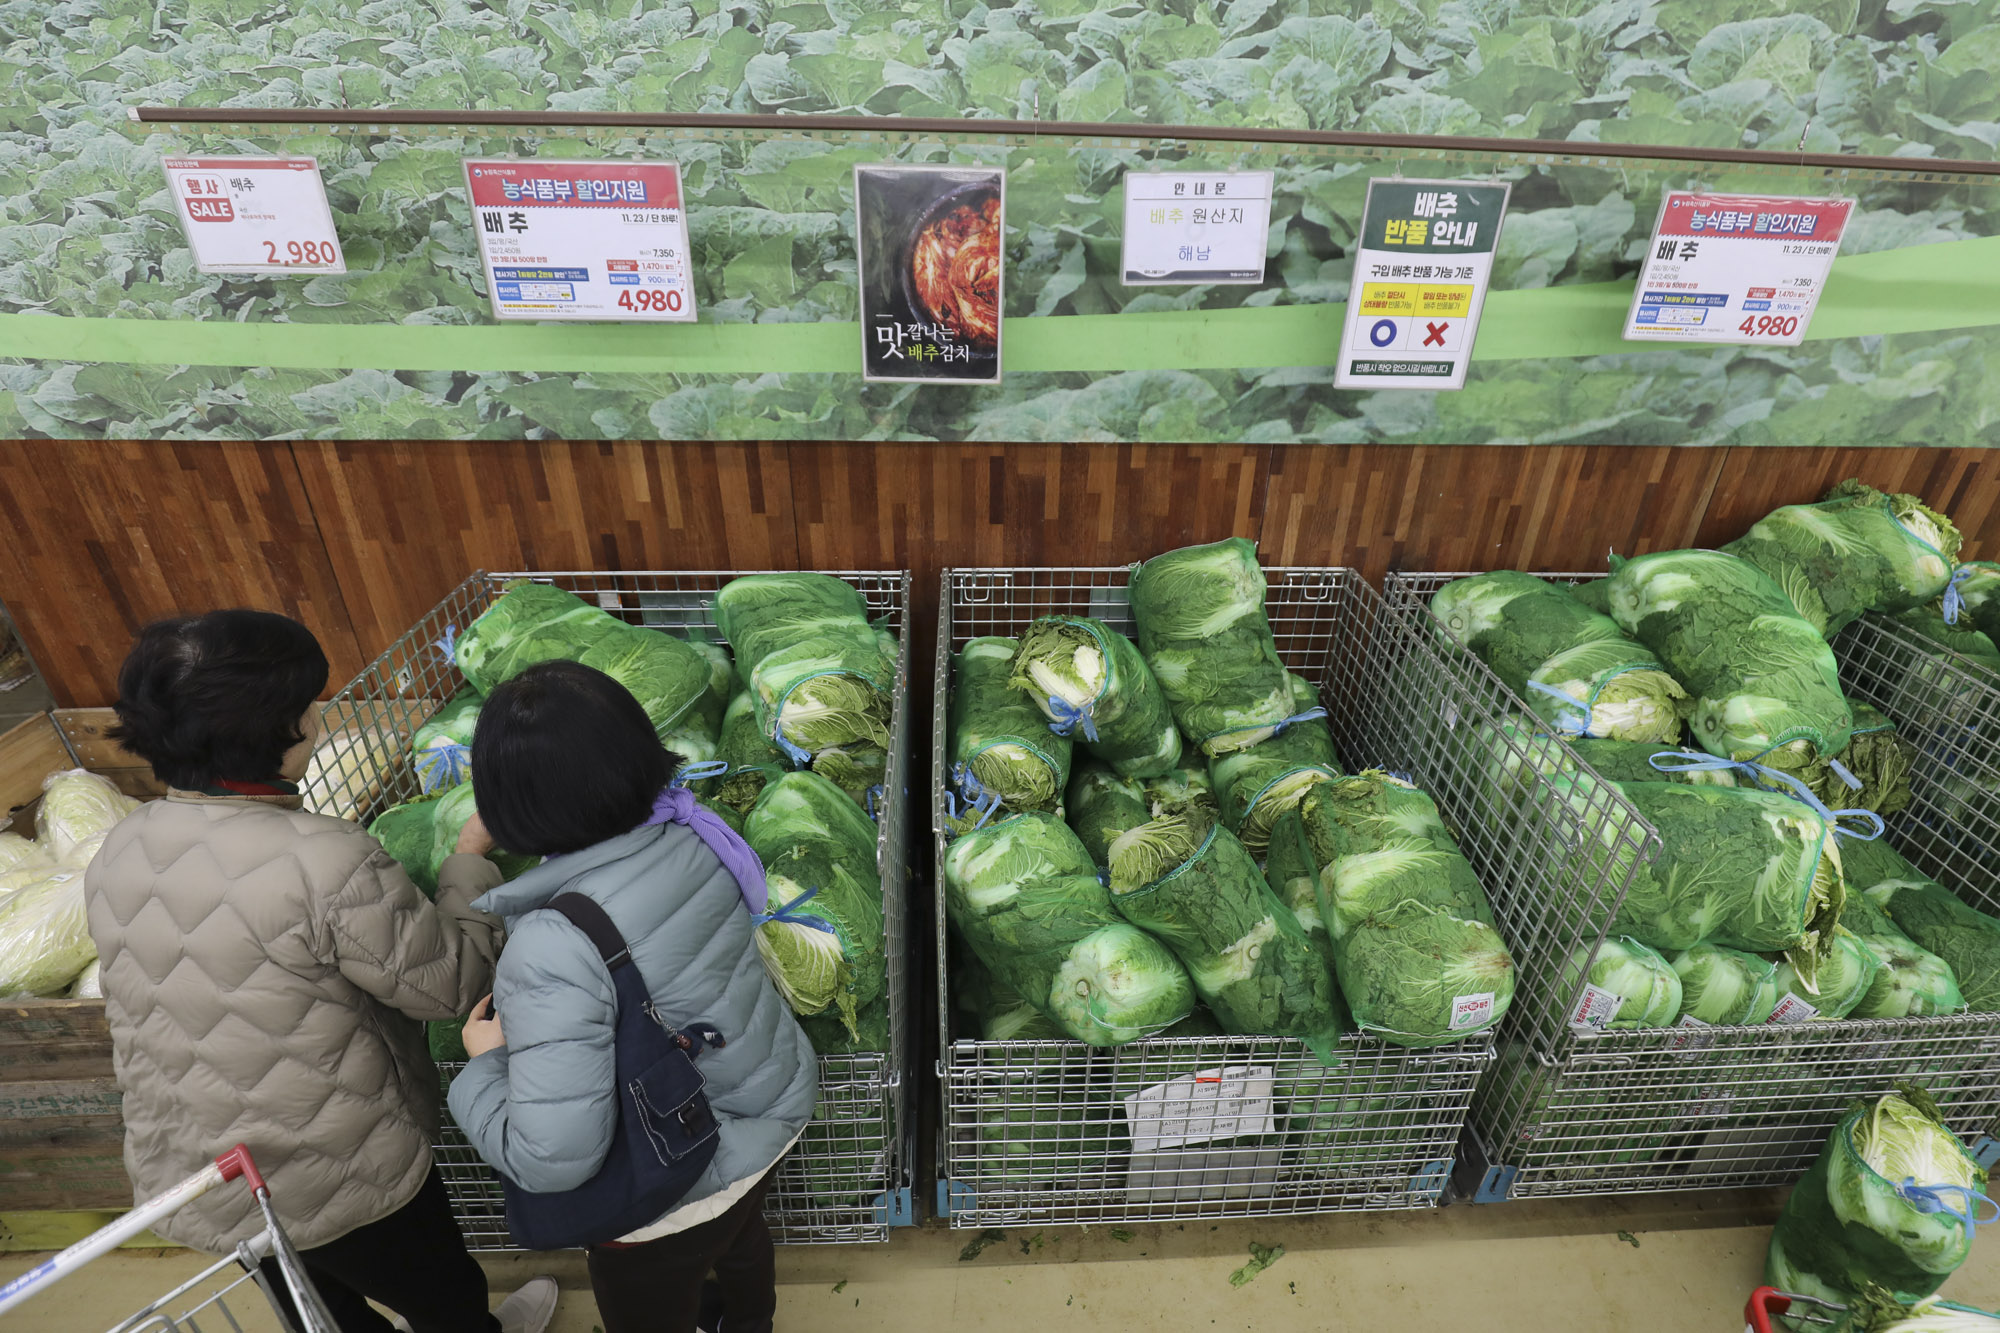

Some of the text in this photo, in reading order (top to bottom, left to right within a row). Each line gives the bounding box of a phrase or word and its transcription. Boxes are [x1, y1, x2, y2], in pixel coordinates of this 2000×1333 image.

[230, 177, 255, 192] 배추
[502, 178, 646, 202] 농식품부 할인지원
[190, 202, 232, 217] SALE
[1413, 192, 1458, 218] 배추
[651, 214, 659, 223] 단
[661, 214, 678, 223] 하루!
[1150, 208, 1243, 224] 배추 원산지
[1690, 210, 1817, 234] 농식품부 할인지원
[1384, 219, 1478, 247] 반품 안내
[262, 240, 336, 266] 2,980
[653, 249, 674, 258] 7,350
[1179, 245, 1211, 261] 해남
[1371, 264, 1474, 279] 구입 배추 반품 가능 기준
[1793, 278, 1811, 287] 7,350
[618, 290, 682, 312] 4,980
[1738, 315, 1798, 337] 4,980
[908, 344, 970, 363] 배추김치
